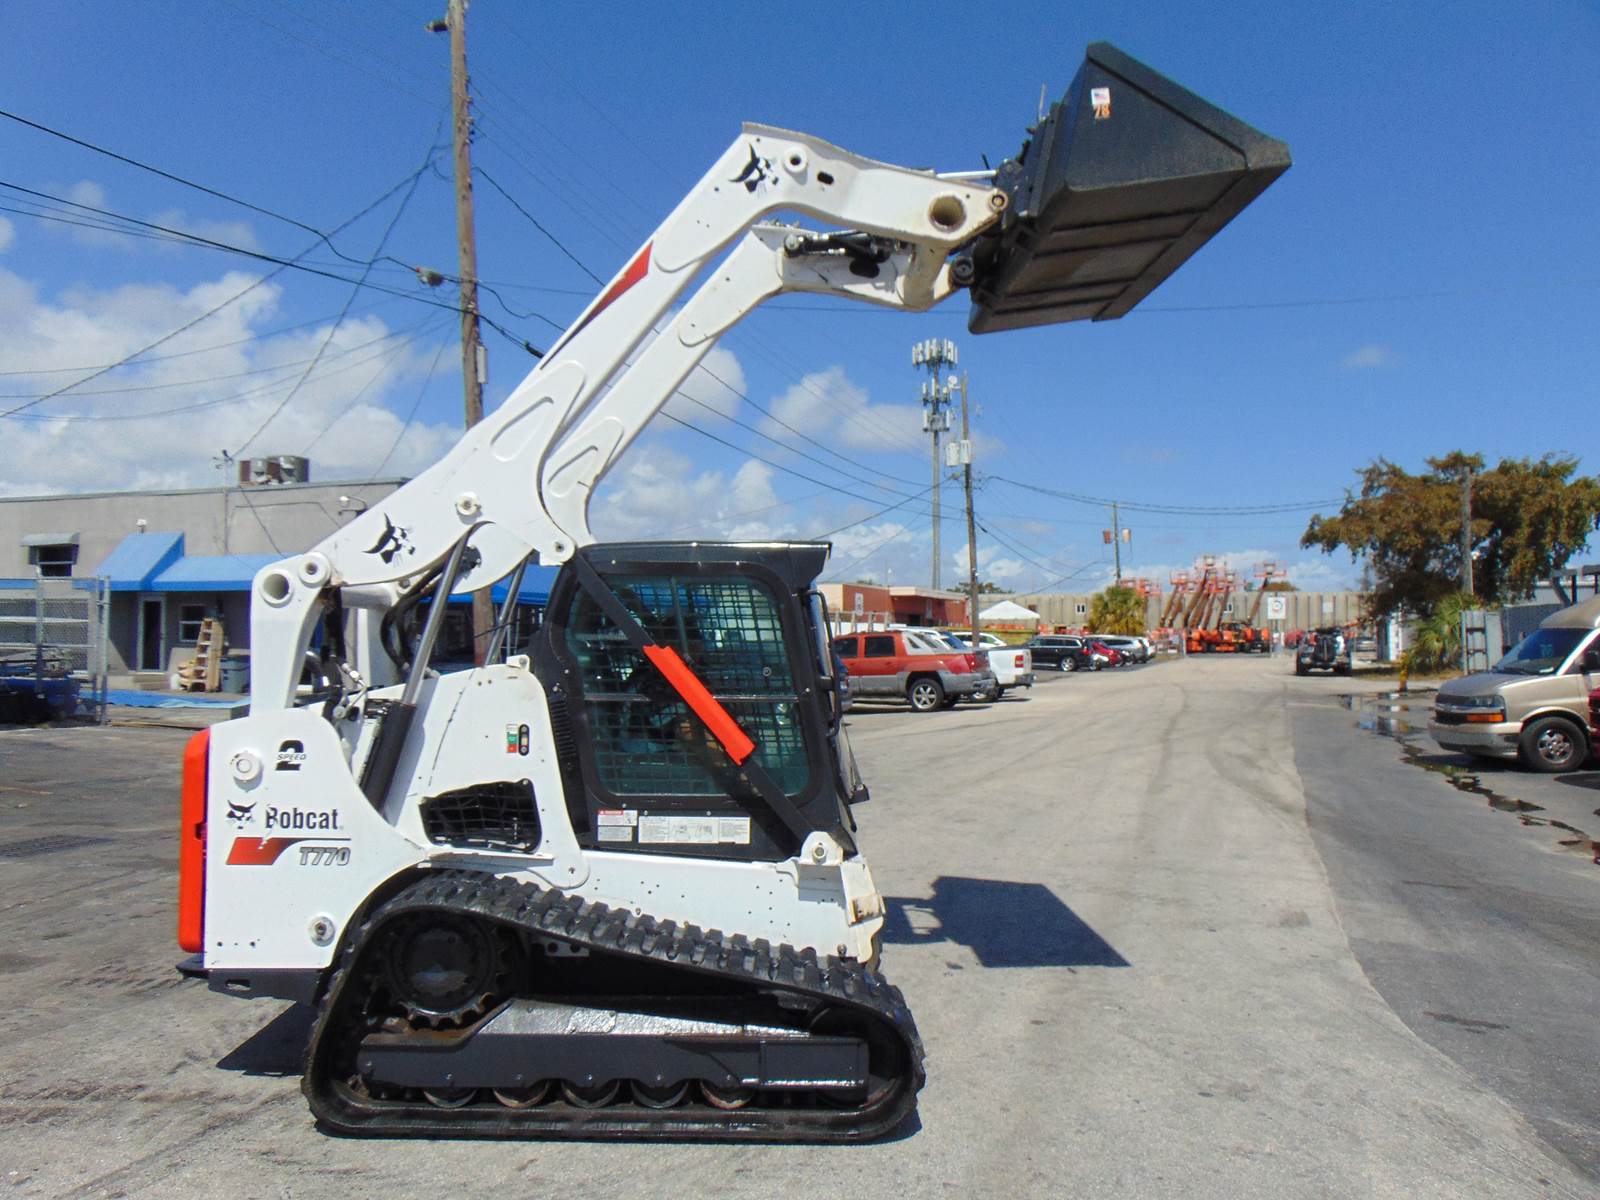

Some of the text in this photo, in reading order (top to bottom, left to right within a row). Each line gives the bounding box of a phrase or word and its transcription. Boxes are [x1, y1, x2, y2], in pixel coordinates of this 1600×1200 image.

[275, 739, 304, 771] 2
[277, 753, 307, 761] SPEED
[265, 807, 339, 829] Bobcat
[299, 847, 351, 866] T770
